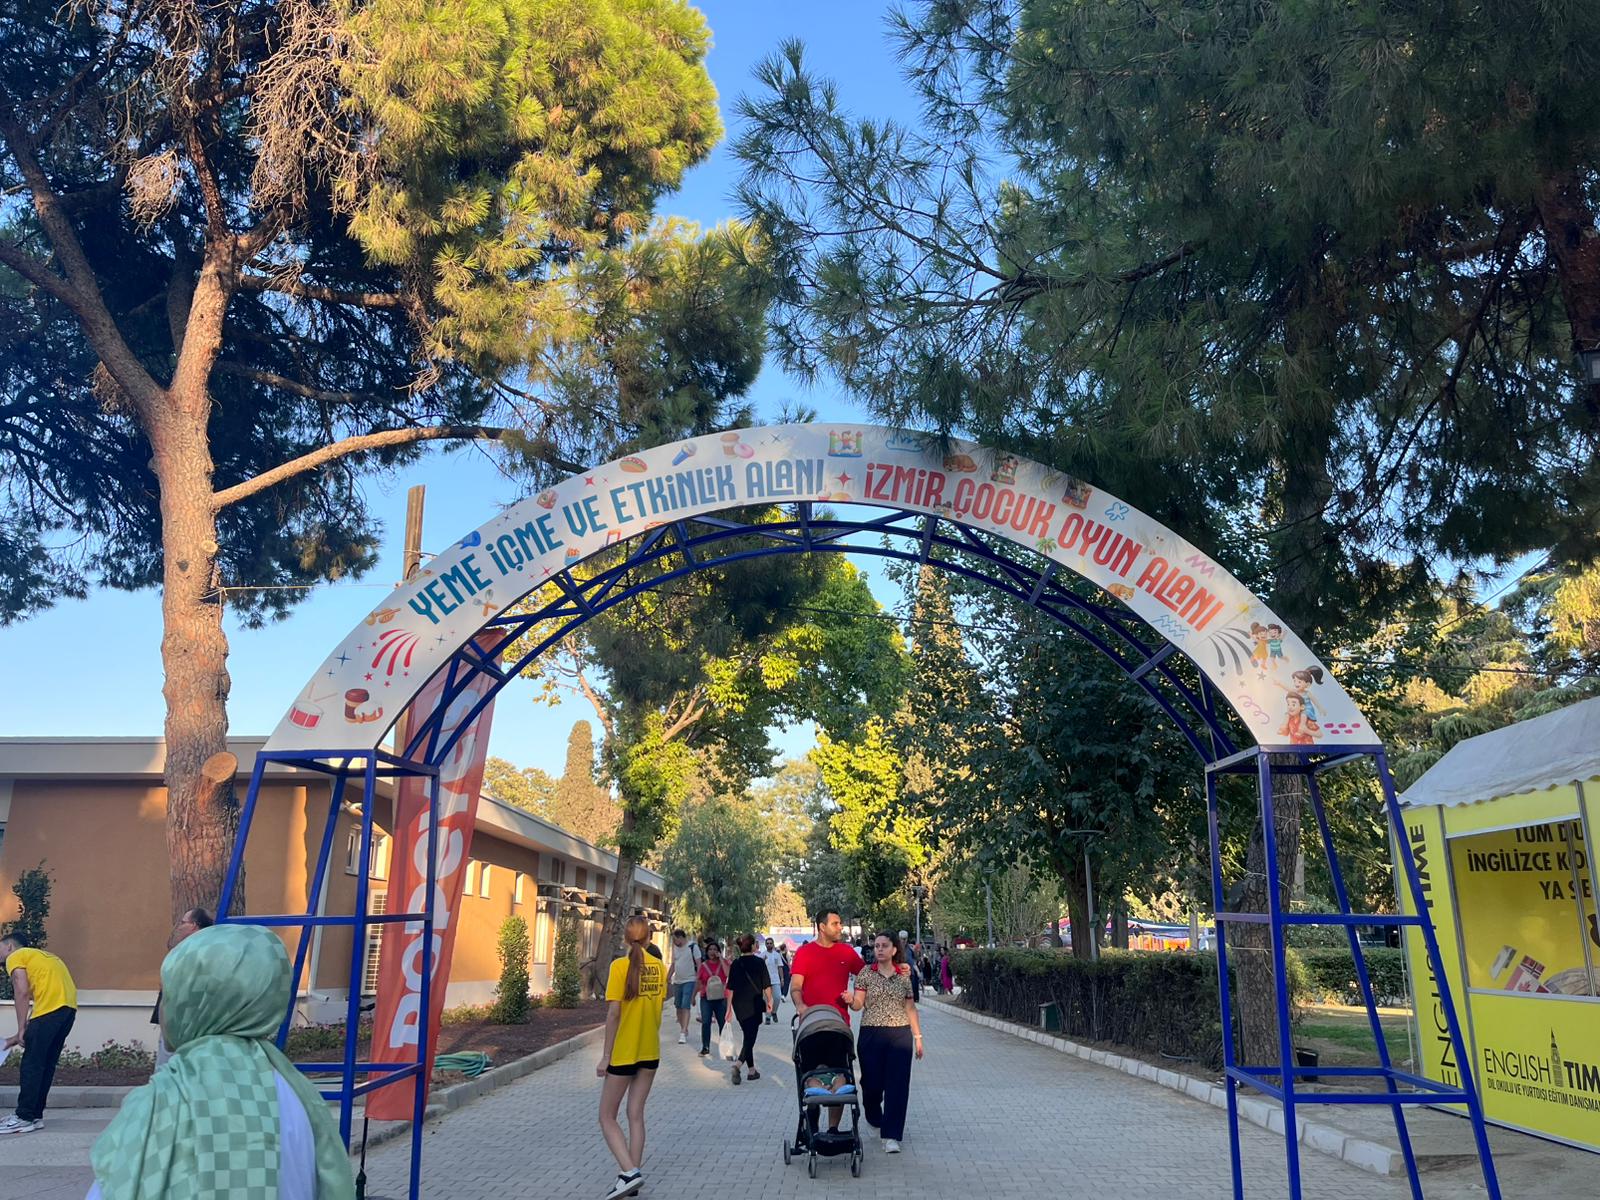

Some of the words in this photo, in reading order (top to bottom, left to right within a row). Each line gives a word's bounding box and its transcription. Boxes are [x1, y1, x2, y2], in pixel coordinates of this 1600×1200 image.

[408, 553, 493, 625] YEME
[486, 513, 564, 576] İÇME
[563, 496, 608, 538] VE
[610, 464, 736, 524] ETKİNLİK
[746, 459, 825, 498] ALANI
[864, 462, 946, 508] İZMİR
[953, 477, 1056, 540] ÇOCUK
[1057, 512, 1143, 578] OYUN
[1135, 556, 1226, 632] ALANI
[1467, 848, 1552, 872] İNGİLİZCE
[1538, 880, 1565, 900] YA
[1483, 1048, 1552, 1085] ENGLISH
